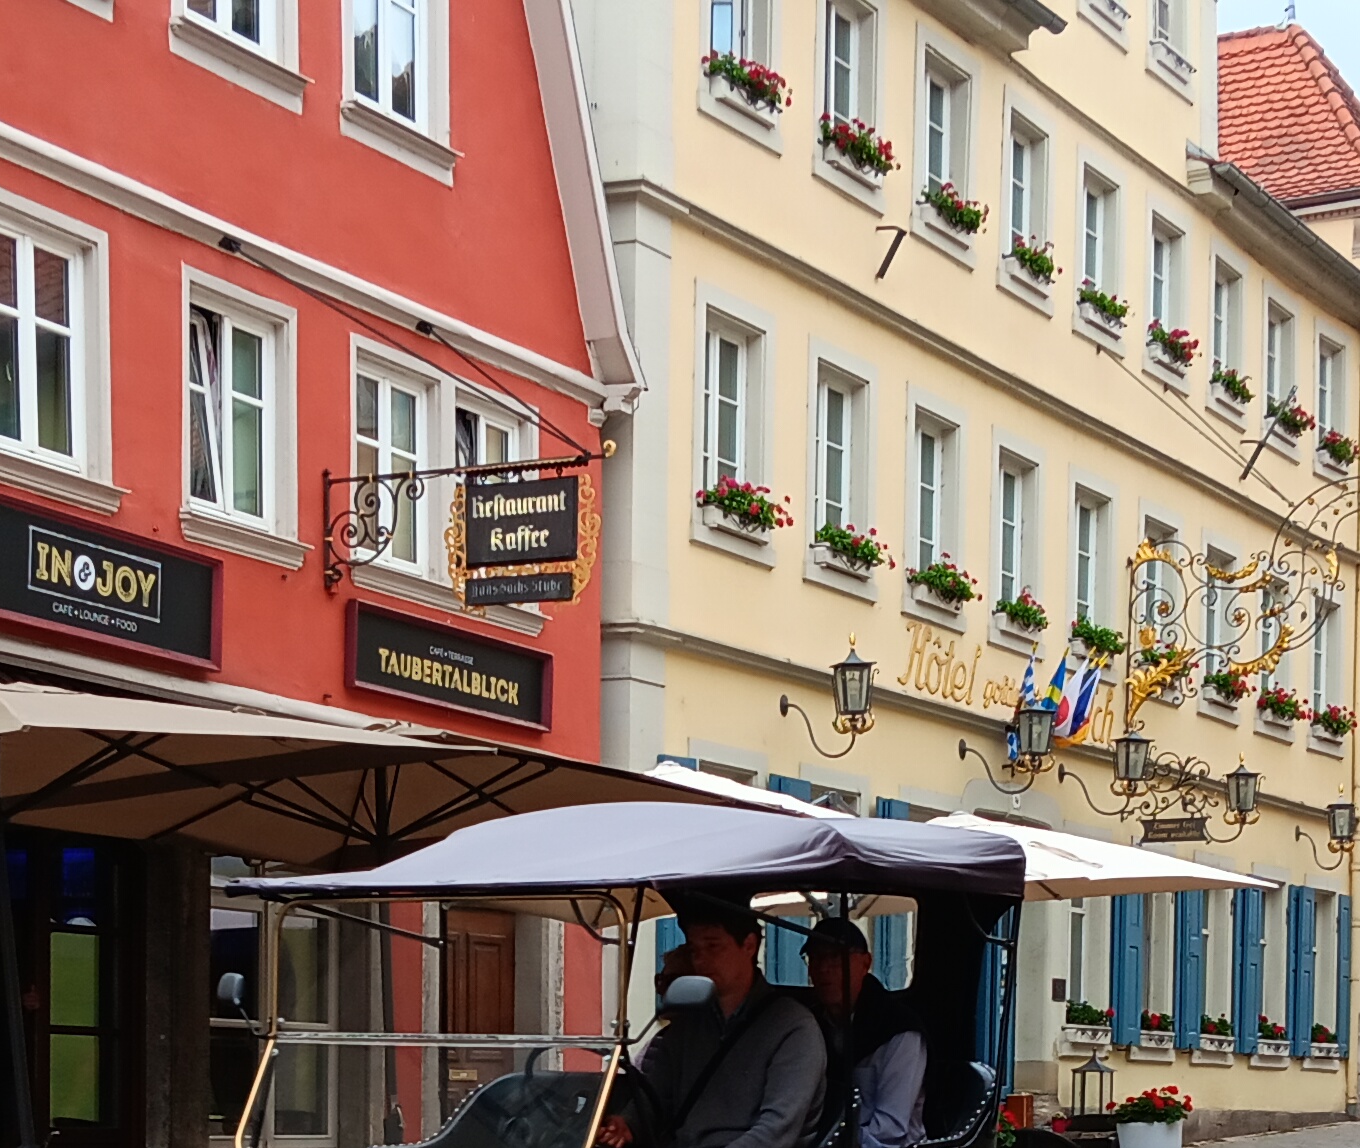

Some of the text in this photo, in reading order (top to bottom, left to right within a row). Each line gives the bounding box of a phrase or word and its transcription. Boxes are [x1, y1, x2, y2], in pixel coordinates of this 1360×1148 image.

[490, 525, 550, 553] Kaffee
[79, 609, 110, 626] LOUNGE
[116, 617, 138, 632] FOOD
[378, 647, 519, 706] TAUBERTALBLICK
[897, 620, 983, 706] Hôtel
